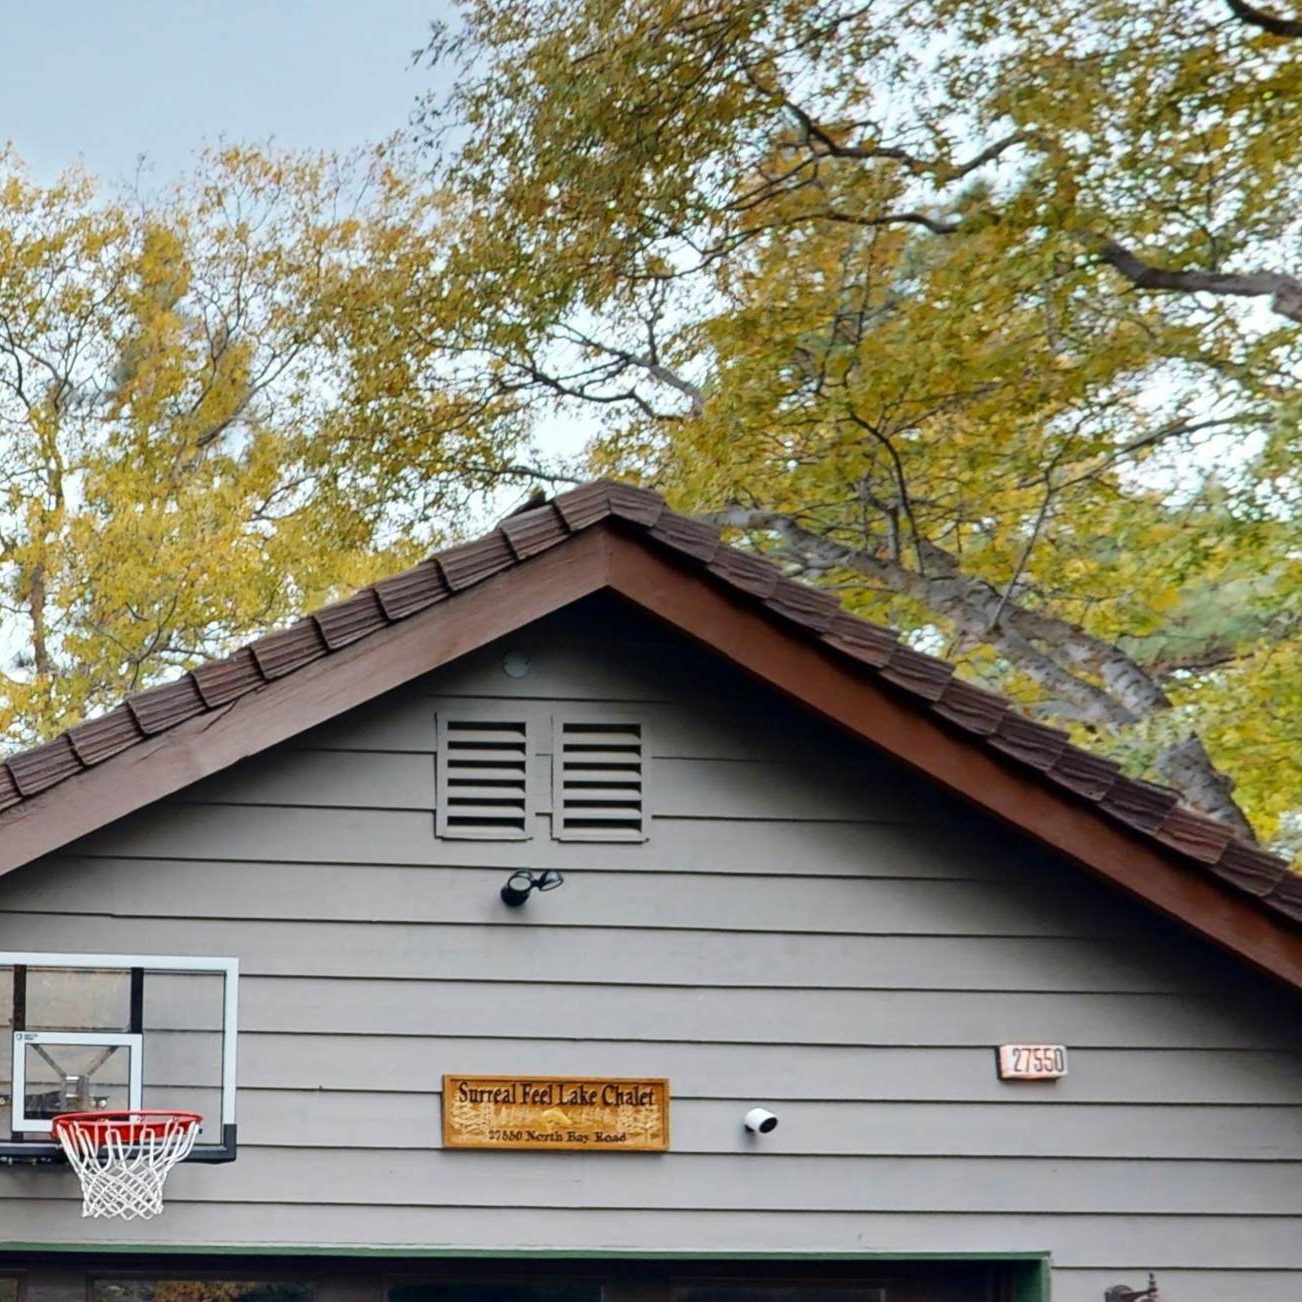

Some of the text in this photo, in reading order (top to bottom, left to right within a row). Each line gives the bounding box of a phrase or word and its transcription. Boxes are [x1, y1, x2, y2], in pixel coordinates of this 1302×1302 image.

[1012, 1047, 1065, 1073] 27550
[458, 1081, 655, 1108] Surreal Feel Lake Chalet
[525, 1130, 564, 1142] North
[565, 1131, 589, 1144] Bay
[594, 1132, 627, 1143] Road
